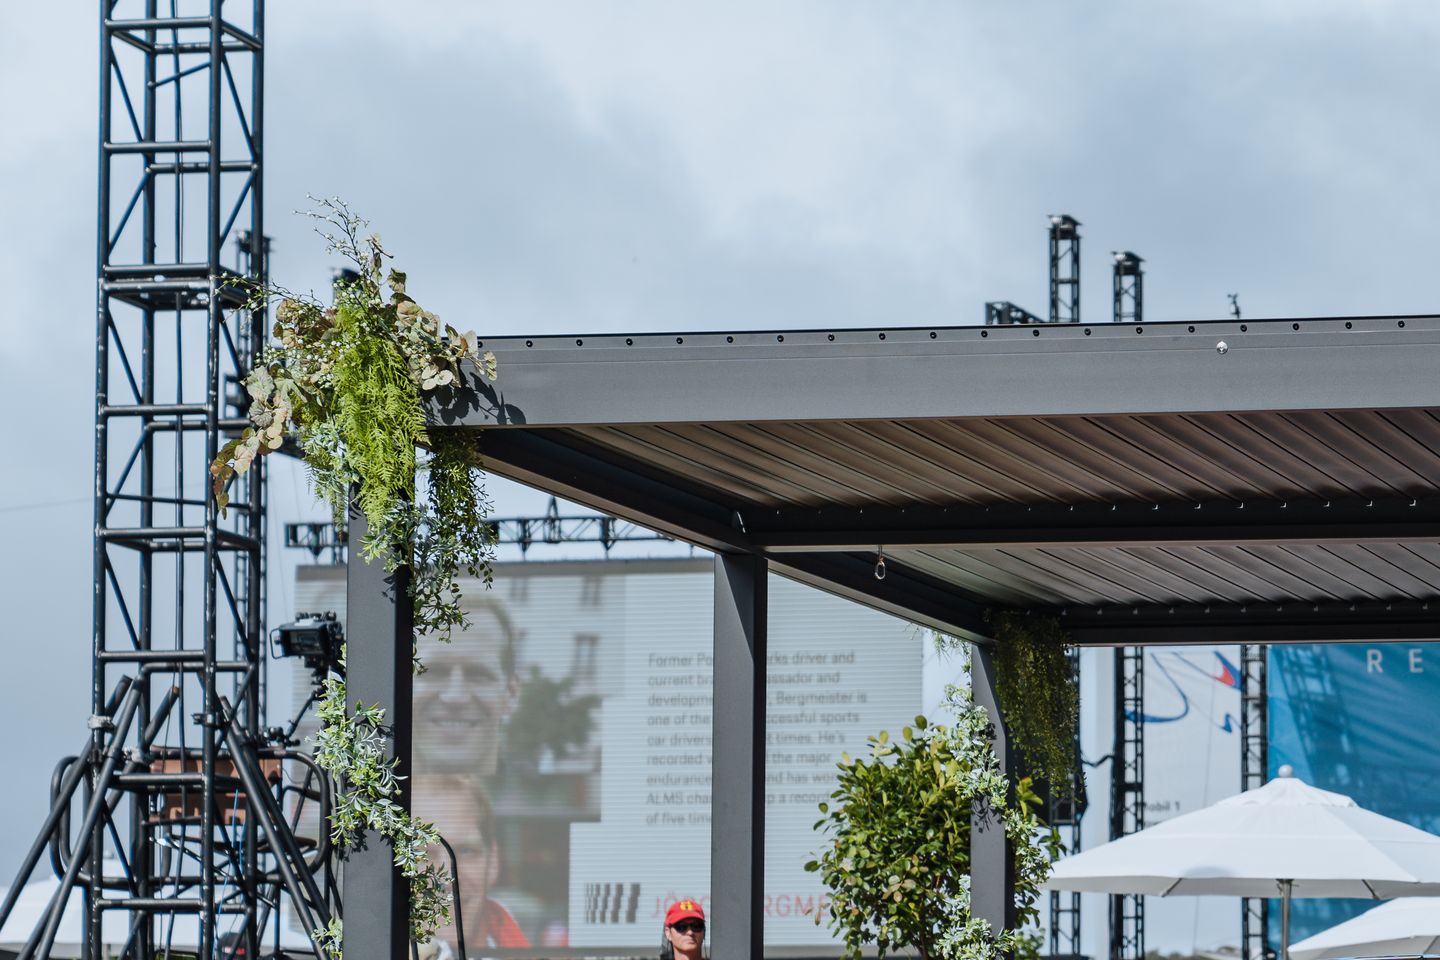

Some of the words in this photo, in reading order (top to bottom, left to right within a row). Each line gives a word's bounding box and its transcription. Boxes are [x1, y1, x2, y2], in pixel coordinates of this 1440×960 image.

[649, 652, 692, 668] Former
[767, 650, 787, 665] rks
[792, 650, 826, 664] driver
[832, 650, 854, 664] and
[648, 674, 692, 687] current
[816, 671, 840, 684] and
[776, 690, 852, 706] Bergmeister
[648, 715, 670, 727] one
[674, 713, 687, 726] of
[690, 713, 710, 726] the
[820, 711, 859, 726] sports
[647, 735, 665, 747] car
[647, 753, 702, 766] recorded
[796, 751, 830, 767] major
[647, 791, 684, 805] ALMS
